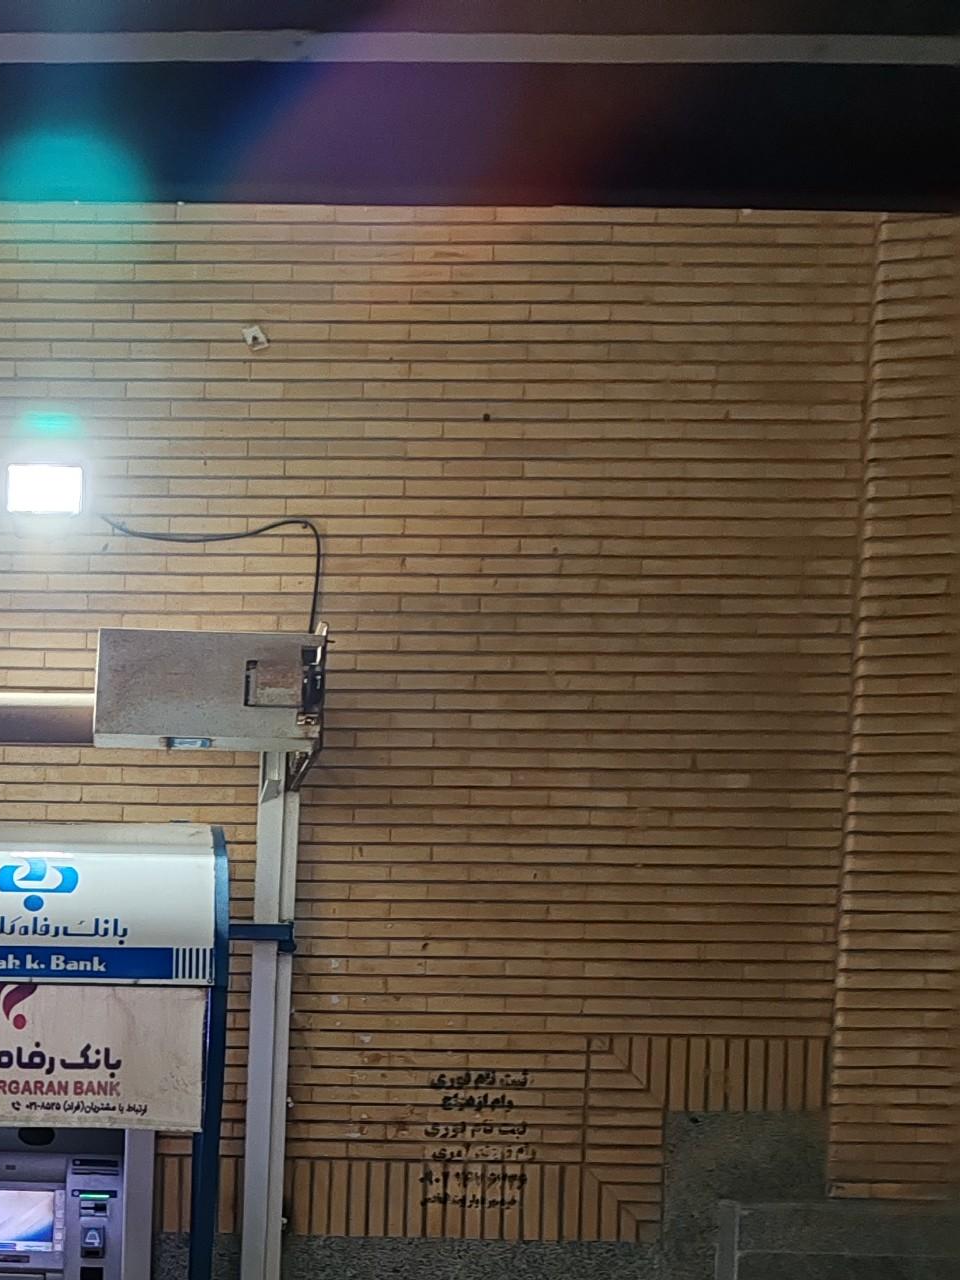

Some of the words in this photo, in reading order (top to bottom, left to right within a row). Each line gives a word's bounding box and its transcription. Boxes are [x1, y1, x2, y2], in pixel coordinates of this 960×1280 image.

[19, 916, 60, 938] رفاه
[62, 916, 129, 946] بانک
[25, 953, 45, 971] k.
[50, 954, 107, 973] Bank
[59, 1042, 123, 1079] بانک
[73, 1079, 121, 1098] BANK
